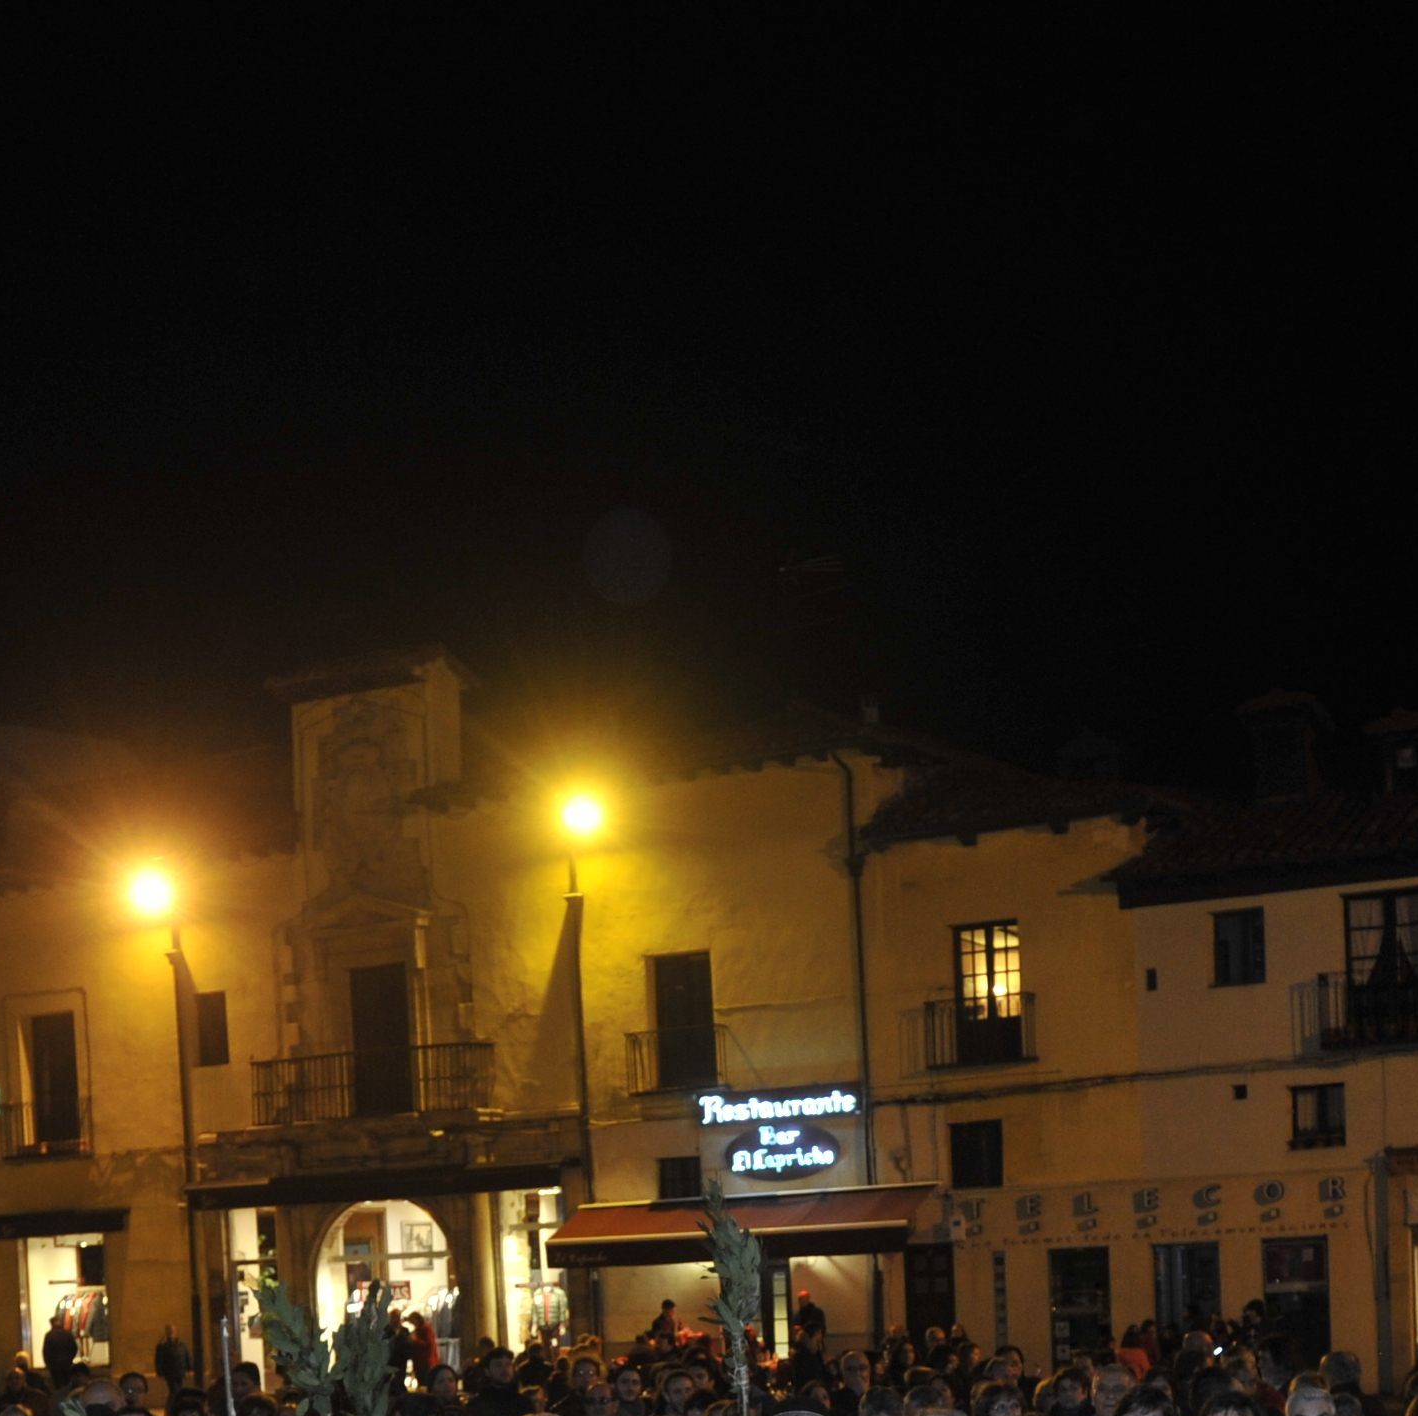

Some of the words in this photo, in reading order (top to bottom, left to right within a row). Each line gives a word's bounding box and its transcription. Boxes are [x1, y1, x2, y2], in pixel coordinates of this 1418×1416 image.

[698, 1090, 857, 1125] Restaurante
[758, 1125, 801, 1146] Bar
[731, 1150, 752, 1172] El
[752, 1146, 835, 1173] Capricho
[967, 1176, 1346, 1219] TELECOR
